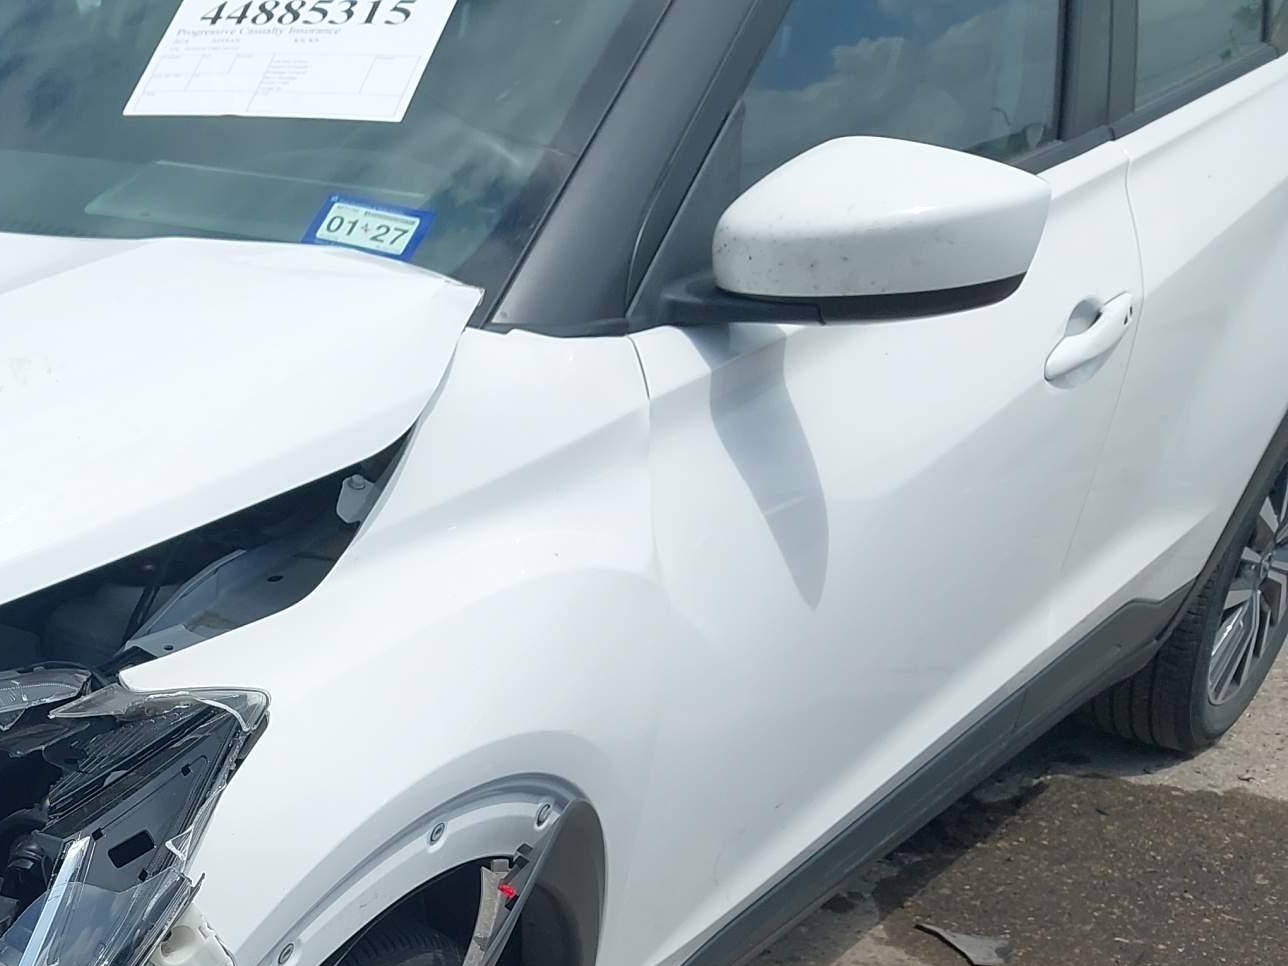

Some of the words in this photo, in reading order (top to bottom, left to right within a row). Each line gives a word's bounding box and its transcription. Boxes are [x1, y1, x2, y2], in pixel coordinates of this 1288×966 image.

[200, 0, 416, 25] 44885315
[177, 27, 236, 37] Progressive
[288, 26, 341, 36] Insurance
[326, 215, 359, 236] 01
[369, 224, 409, 245] 27
